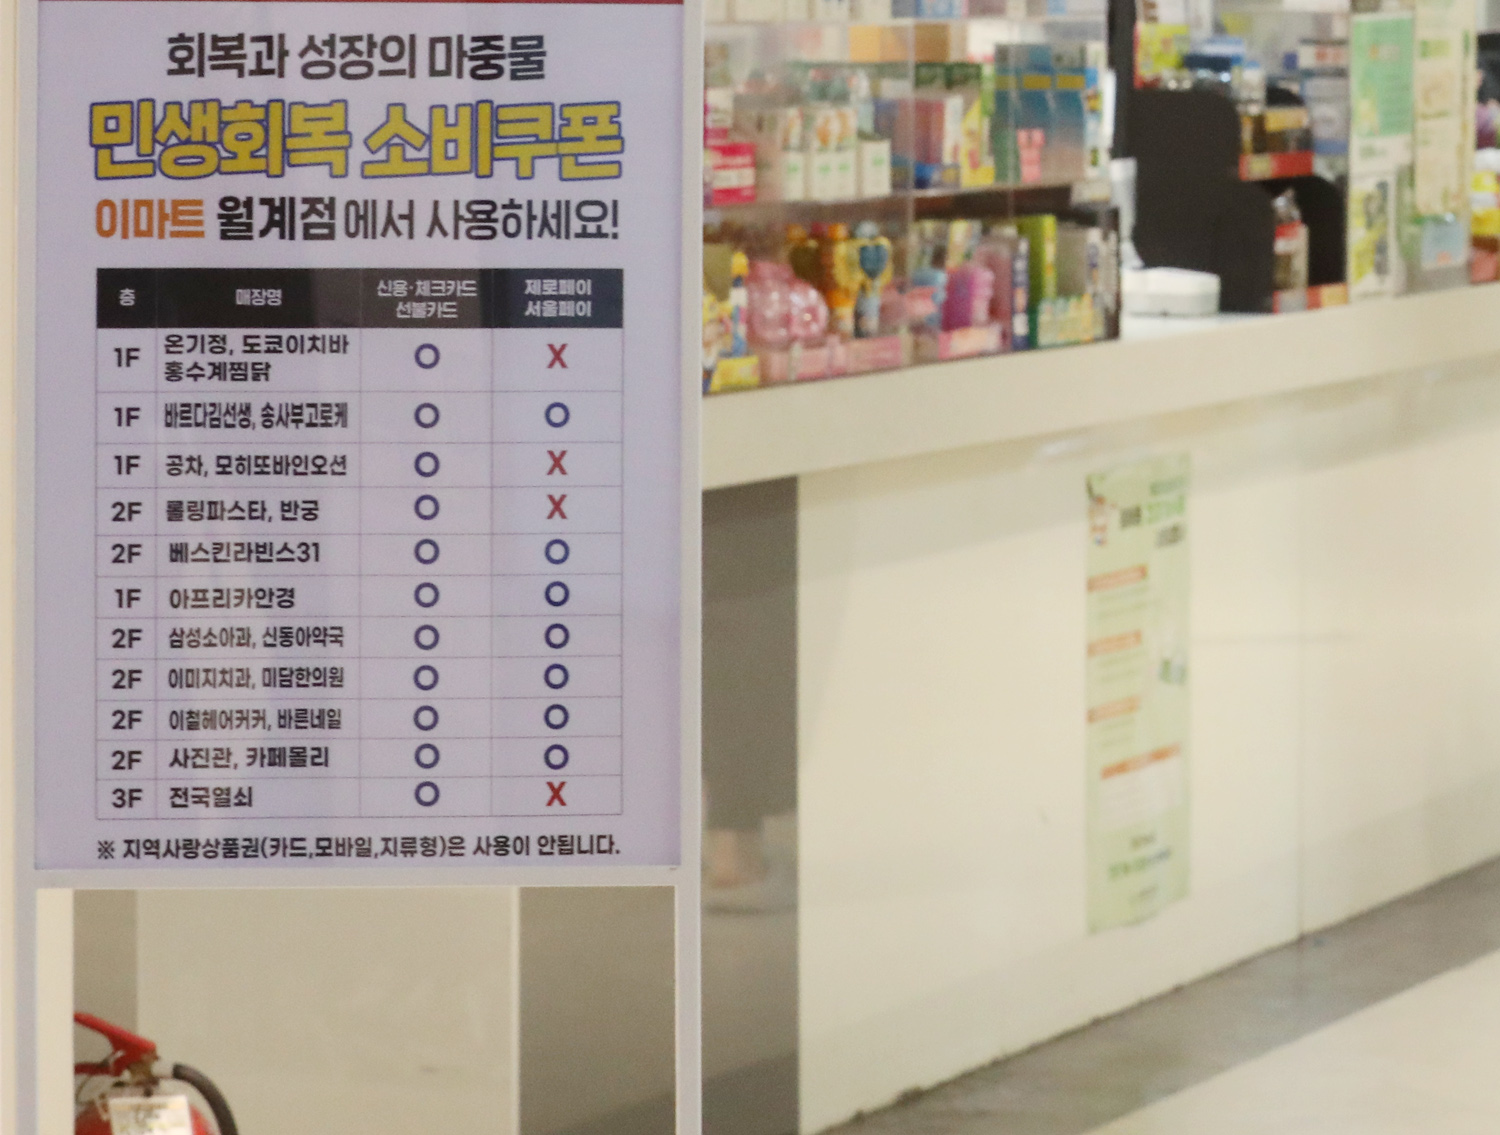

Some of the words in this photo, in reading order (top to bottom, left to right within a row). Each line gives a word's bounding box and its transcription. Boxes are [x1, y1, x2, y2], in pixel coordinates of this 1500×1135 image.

[166, 32, 290, 79] 회복과
[298, 33, 417, 81] 성장의
[428, 34, 547, 81] 마중물
[87, 97, 354, 183] 민생회복
[359, 98, 626, 184] 소비쿠폰
[95, 198, 206, 240] 이마트
[426, 198, 619, 241] 사용하세요!
[119, 287, 136, 307] 층
[235, 288, 283, 307] 매장명
[524, 278, 592, 296] 제로페이
[396, 301, 458, 319] 선불카드
[524, 299, 592, 318] 서울페이
[164, 333, 234, 356] 온기정,
[242, 334, 349, 355] 도쿄이치바
[113, 347, 141, 368] 1F
[164, 360, 272, 383] 홍수계찜닭
[114, 406, 141, 427] 1F
[164, 402, 256, 430] 바르다김선생,
[260, 402, 348, 430] 송사부고로케
[114, 455, 141, 476] 1F
[165, 454, 208, 478] 공차,
[215, 454, 347, 477] 모히또바인오션
[111, 501, 143, 522] 2F
[166, 500, 273, 523] 롤링파스타,
[280, 499, 320, 522] 반궁
[111, 543, 142, 564] 2F
[169, 541, 320, 564] 베스킨라빈스31
[114, 588, 142, 609] 1F
[169, 587, 295, 610] 아프리카안경
[111, 628, 143, 649] 2F
[168, 626, 256, 649] 삼성소아과,
[262, 625, 344, 648] 신동아약국
[111, 668, 143, 690] 2F
[167, 667, 256, 690] 이미지치과,
[262, 666, 344, 689] 미담한의원
[111, 709, 143, 730] 2F
[168, 708, 272, 732] 이철헤어커커,
[277, 708, 342, 730] 바른네일
[111, 749, 142, 771] 2F
[168, 747, 238, 770] 사진관,
[246, 746, 329, 768] 카페몰리
[112, 787, 143, 809] 3F
[169, 786, 253, 809] 전국열쇠
[122, 835, 466, 860] 지역사랑상품권(카드,모바일,지류형)은
[472, 835, 530, 857] 사용이
[537, 834, 620, 856] 안됩니다.
